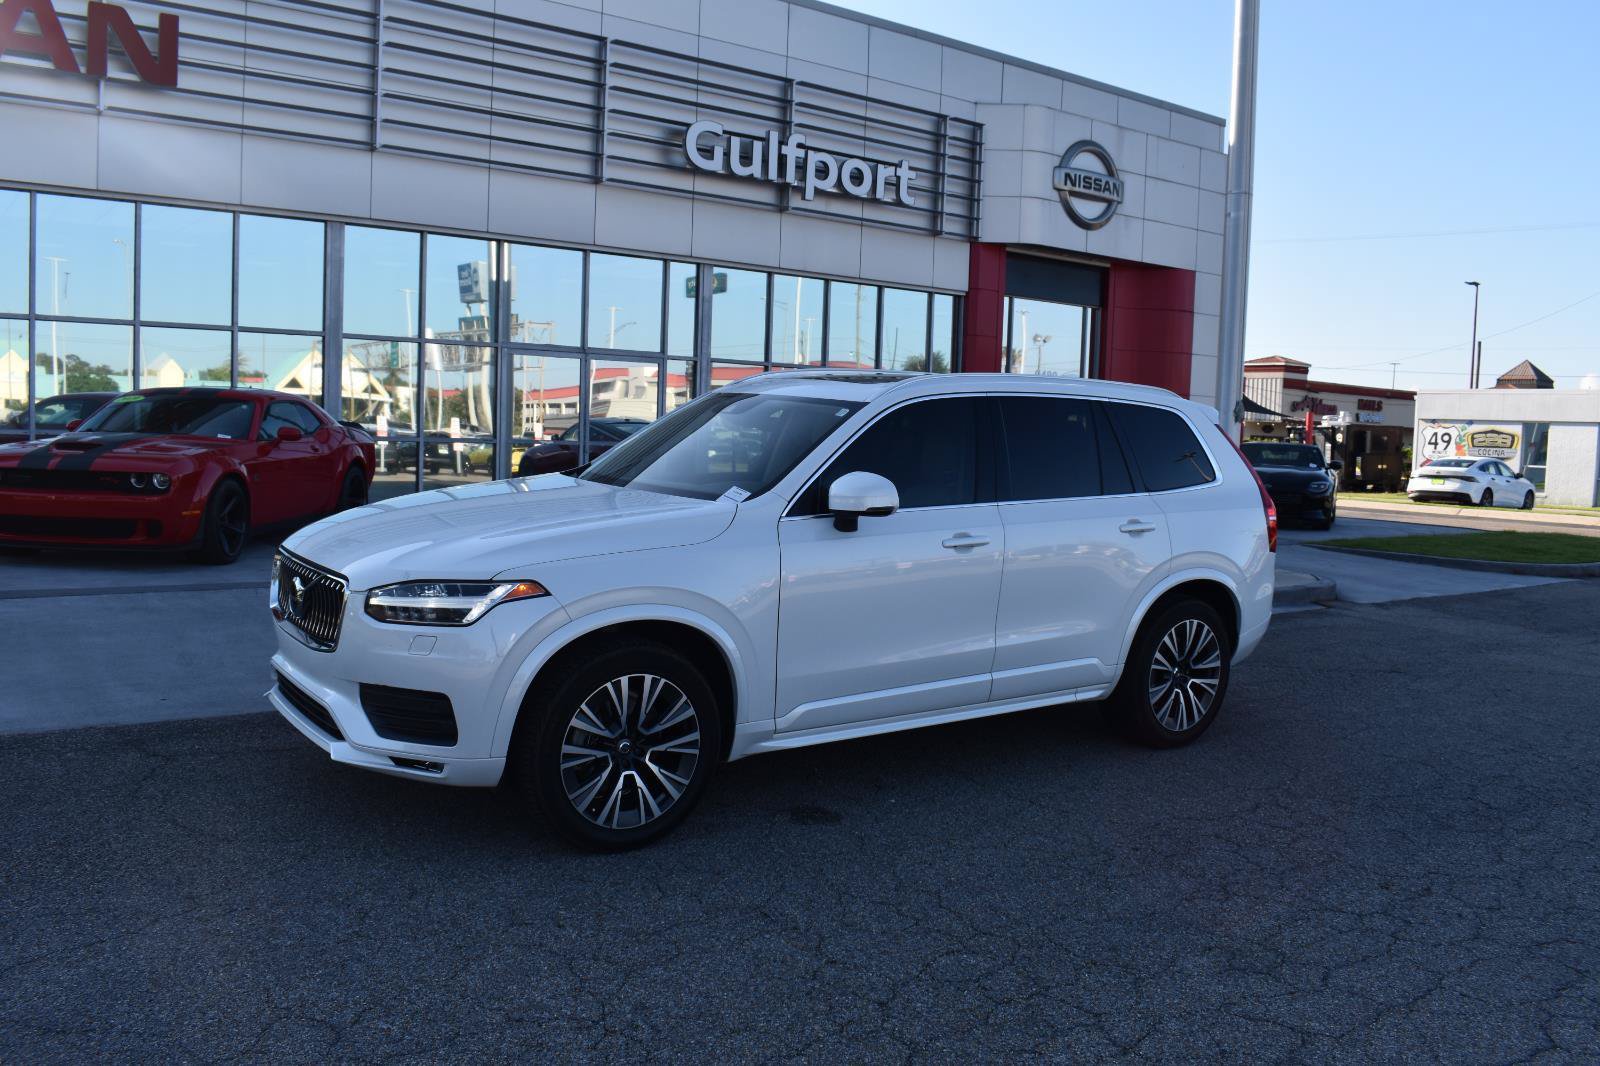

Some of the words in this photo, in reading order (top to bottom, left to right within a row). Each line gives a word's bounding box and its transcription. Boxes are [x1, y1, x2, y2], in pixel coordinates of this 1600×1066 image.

[684, 120, 917, 207] Gulfport
[1064, 172, 1120, 197] NISSAN
[1428, 432, 1452, 451] 49
[1477, 448, 1506, 456] COCINA
